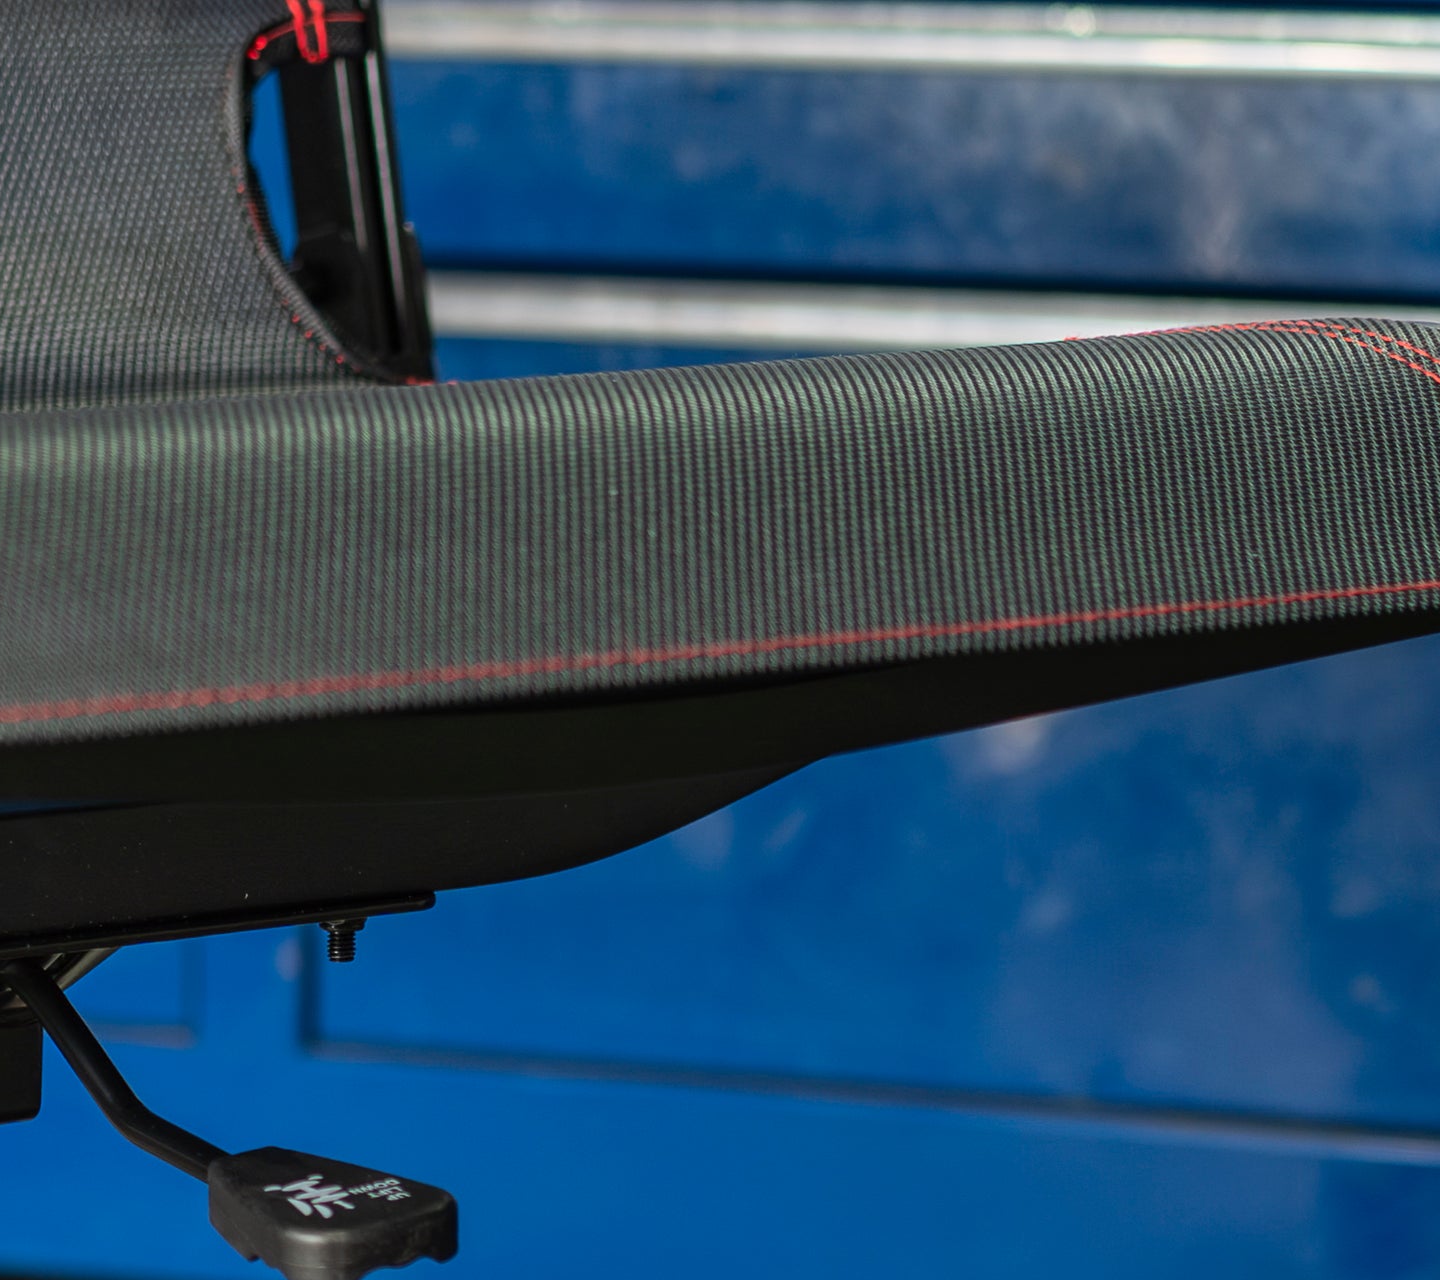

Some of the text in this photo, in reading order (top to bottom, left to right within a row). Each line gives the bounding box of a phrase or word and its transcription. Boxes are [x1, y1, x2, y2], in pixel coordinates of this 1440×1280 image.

[348, 1178, 400, 1195] DOWN
[367, 1186, 403, 1199] LIFT
[386, 1190, 410, 1201] UP
